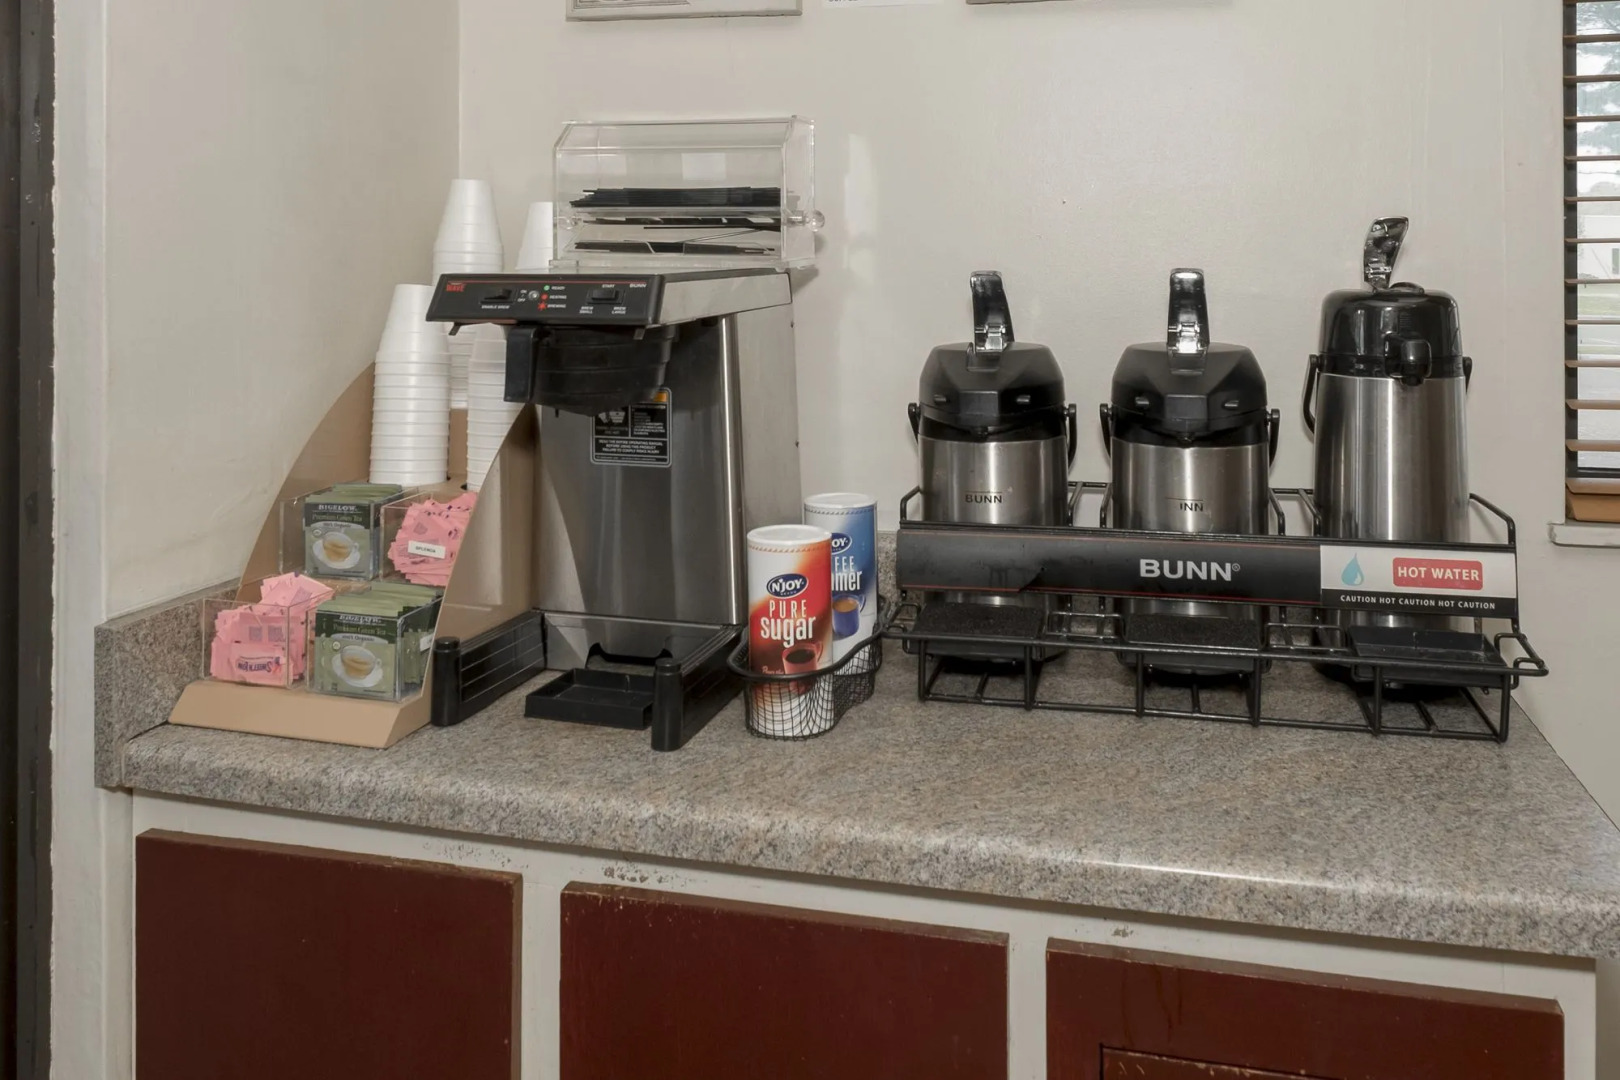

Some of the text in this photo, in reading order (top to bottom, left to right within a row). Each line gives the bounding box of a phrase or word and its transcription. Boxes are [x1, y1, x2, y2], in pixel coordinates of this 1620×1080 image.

[965, 494, 1002, 503] BUNN
[831, 537, 846, 548] OY
[834, 555, 855, 572] FEE
[1140, 558, 1232, 581] BUNN
[1397, 566, 1480, 581] HOT WATER
[769, 599, 807, 619] PURE
[1340, 594, 1377, 603] CAUTION
[1398, 598, 1436, 607] CAUTION
[1458, 601, 1496, 610] CAUTION
[760, 616, 817, 648] sugar
